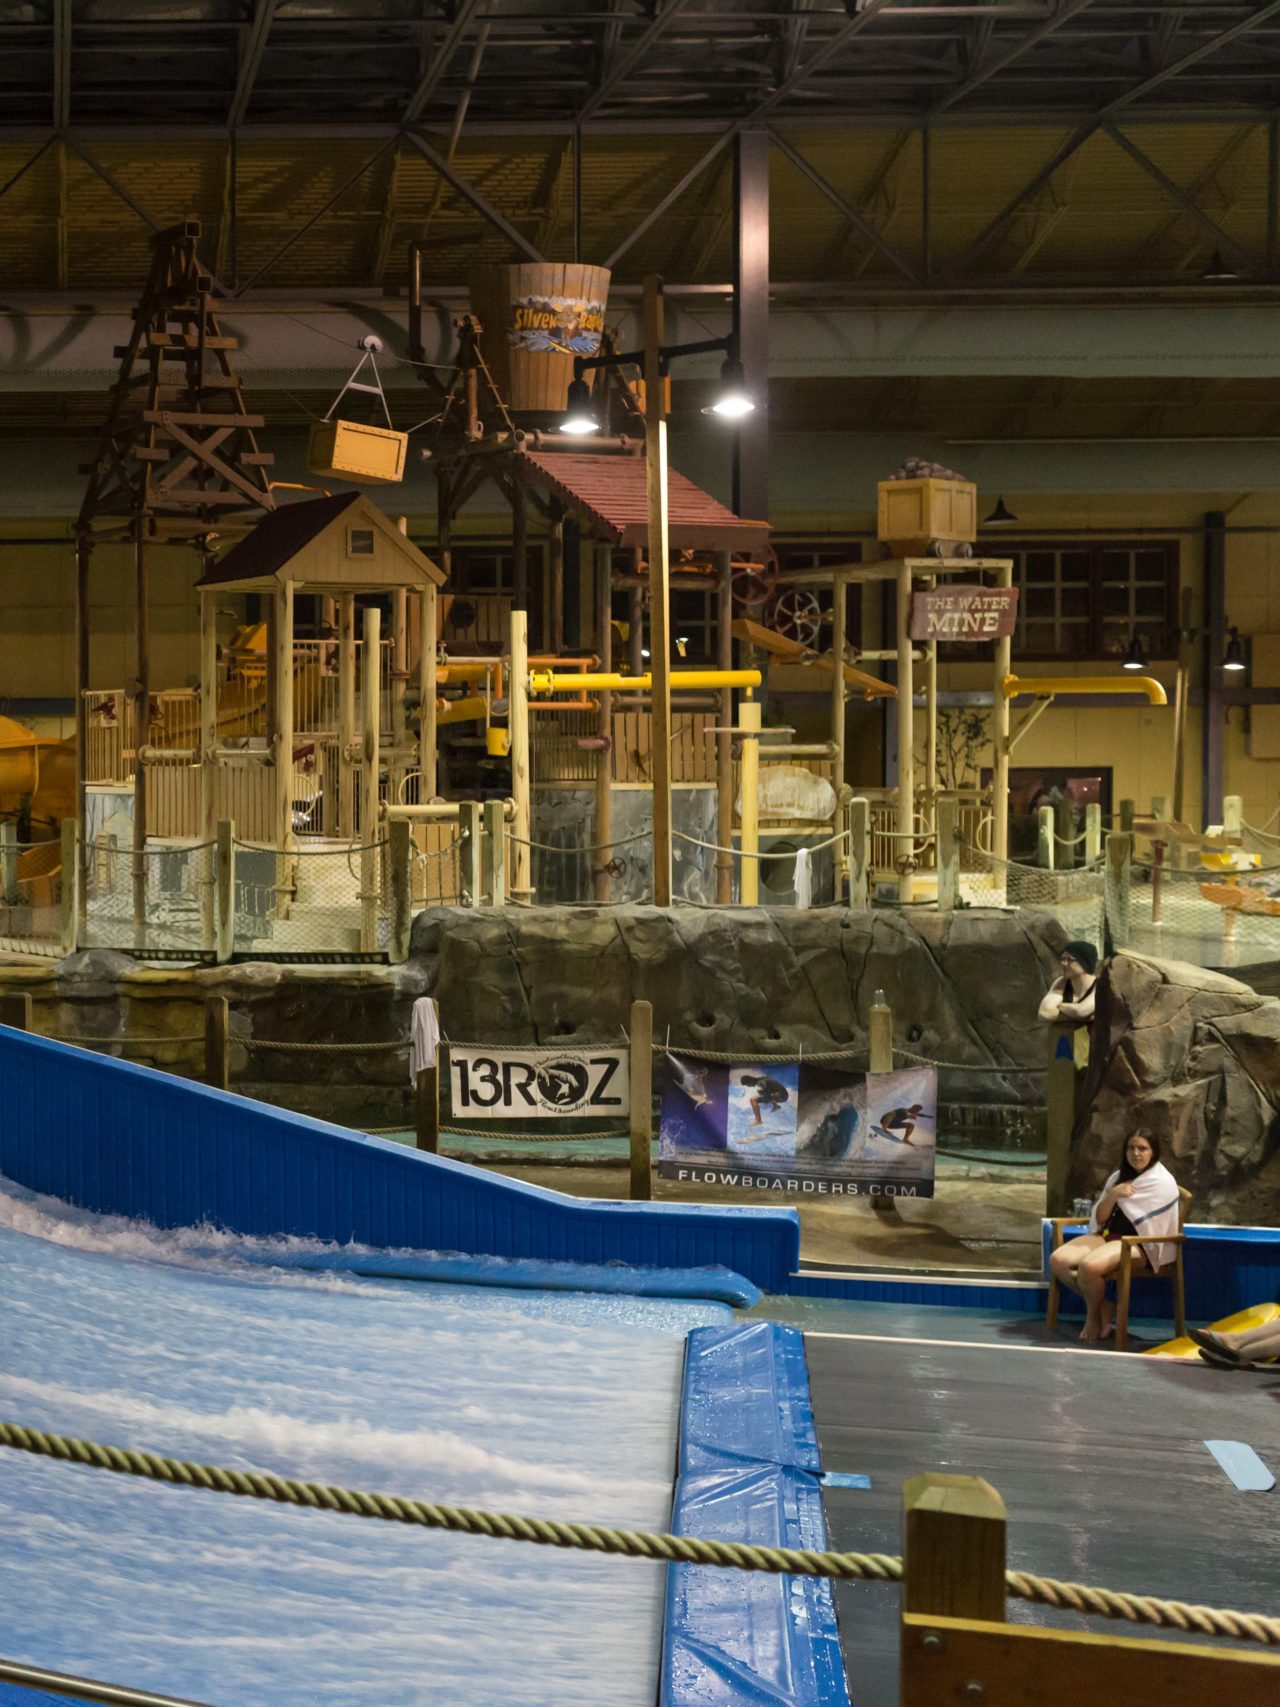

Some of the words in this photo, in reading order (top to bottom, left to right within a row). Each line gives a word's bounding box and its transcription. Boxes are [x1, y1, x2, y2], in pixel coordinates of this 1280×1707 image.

[514, 308, 558, 330] Silver
[926, 597, 955, 610] THE
[959, 597, 1011, 610] WATER
[927, 612, 1000, 632] MINE
[451, 1056, 622, 1107] 13ROZ
[678, 1169, 917, 1198] FLOWBOARDERS.COM
